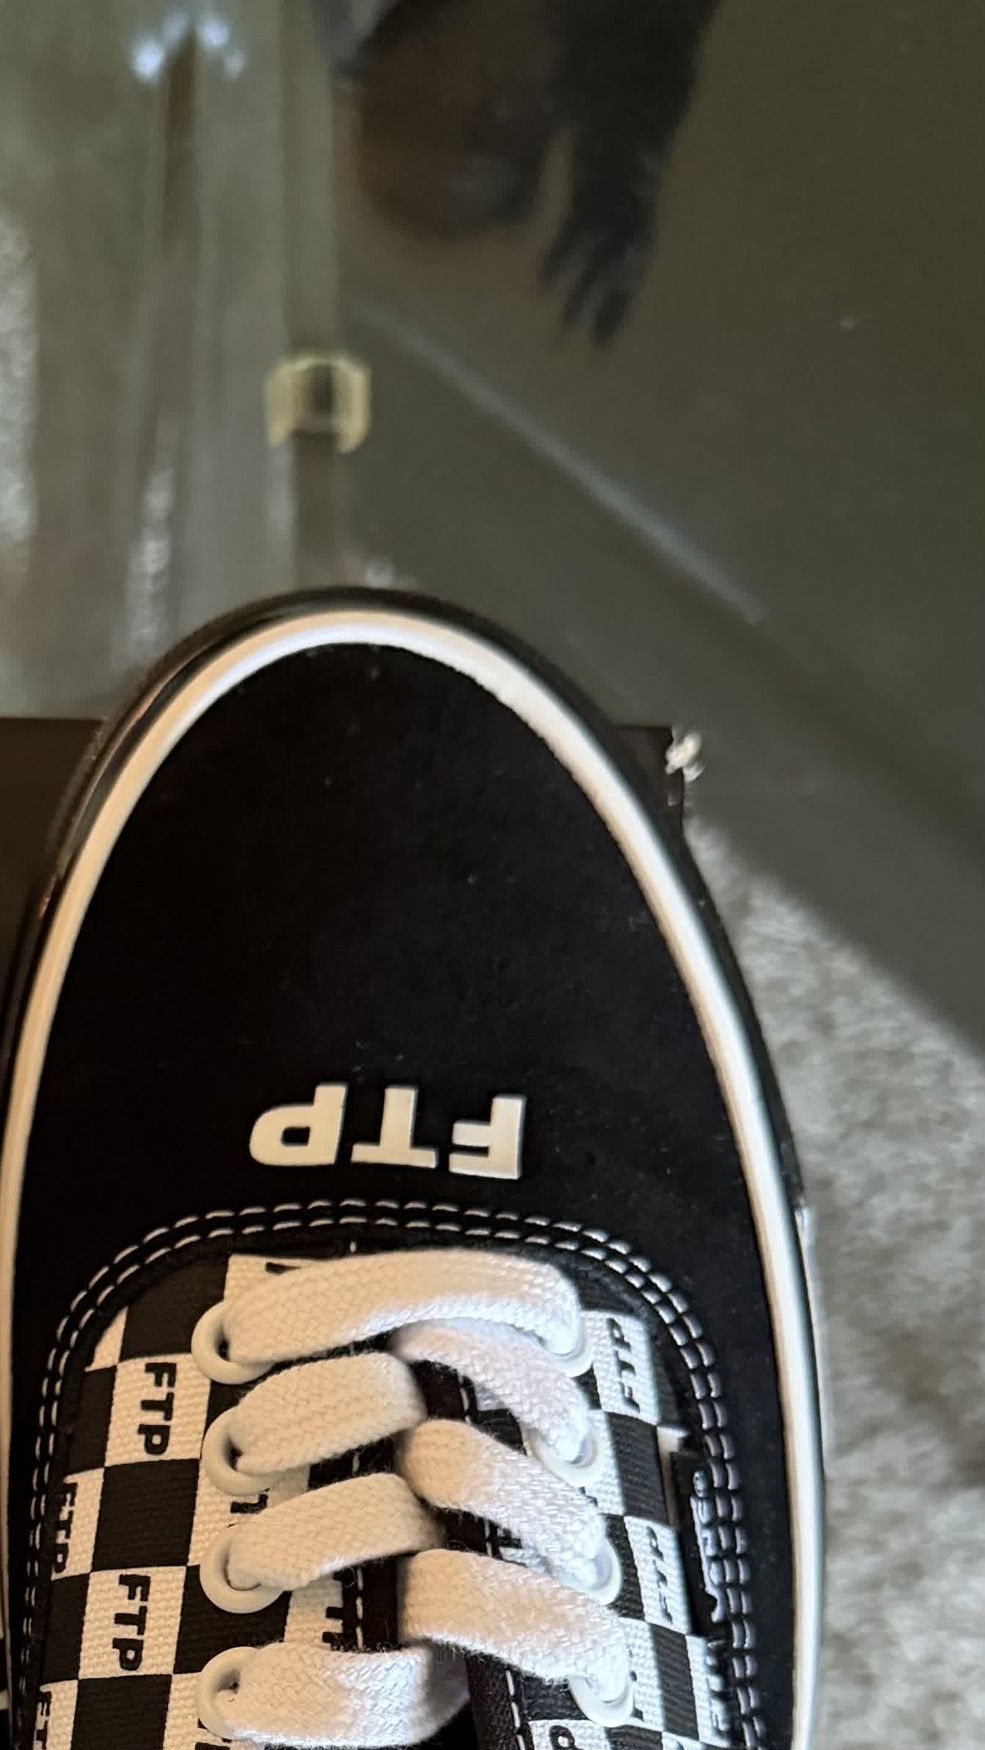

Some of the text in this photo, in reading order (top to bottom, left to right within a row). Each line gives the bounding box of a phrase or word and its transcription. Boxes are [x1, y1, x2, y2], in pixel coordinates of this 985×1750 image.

[249, 1082, 525, 1179] FTP
[137, 1362, 177, 1456] FTP
[607, 1317, 640, 1412] FTP
[112, 1573, 151, 1671] FTP
[646, 1525, 672, 1623] FTP
